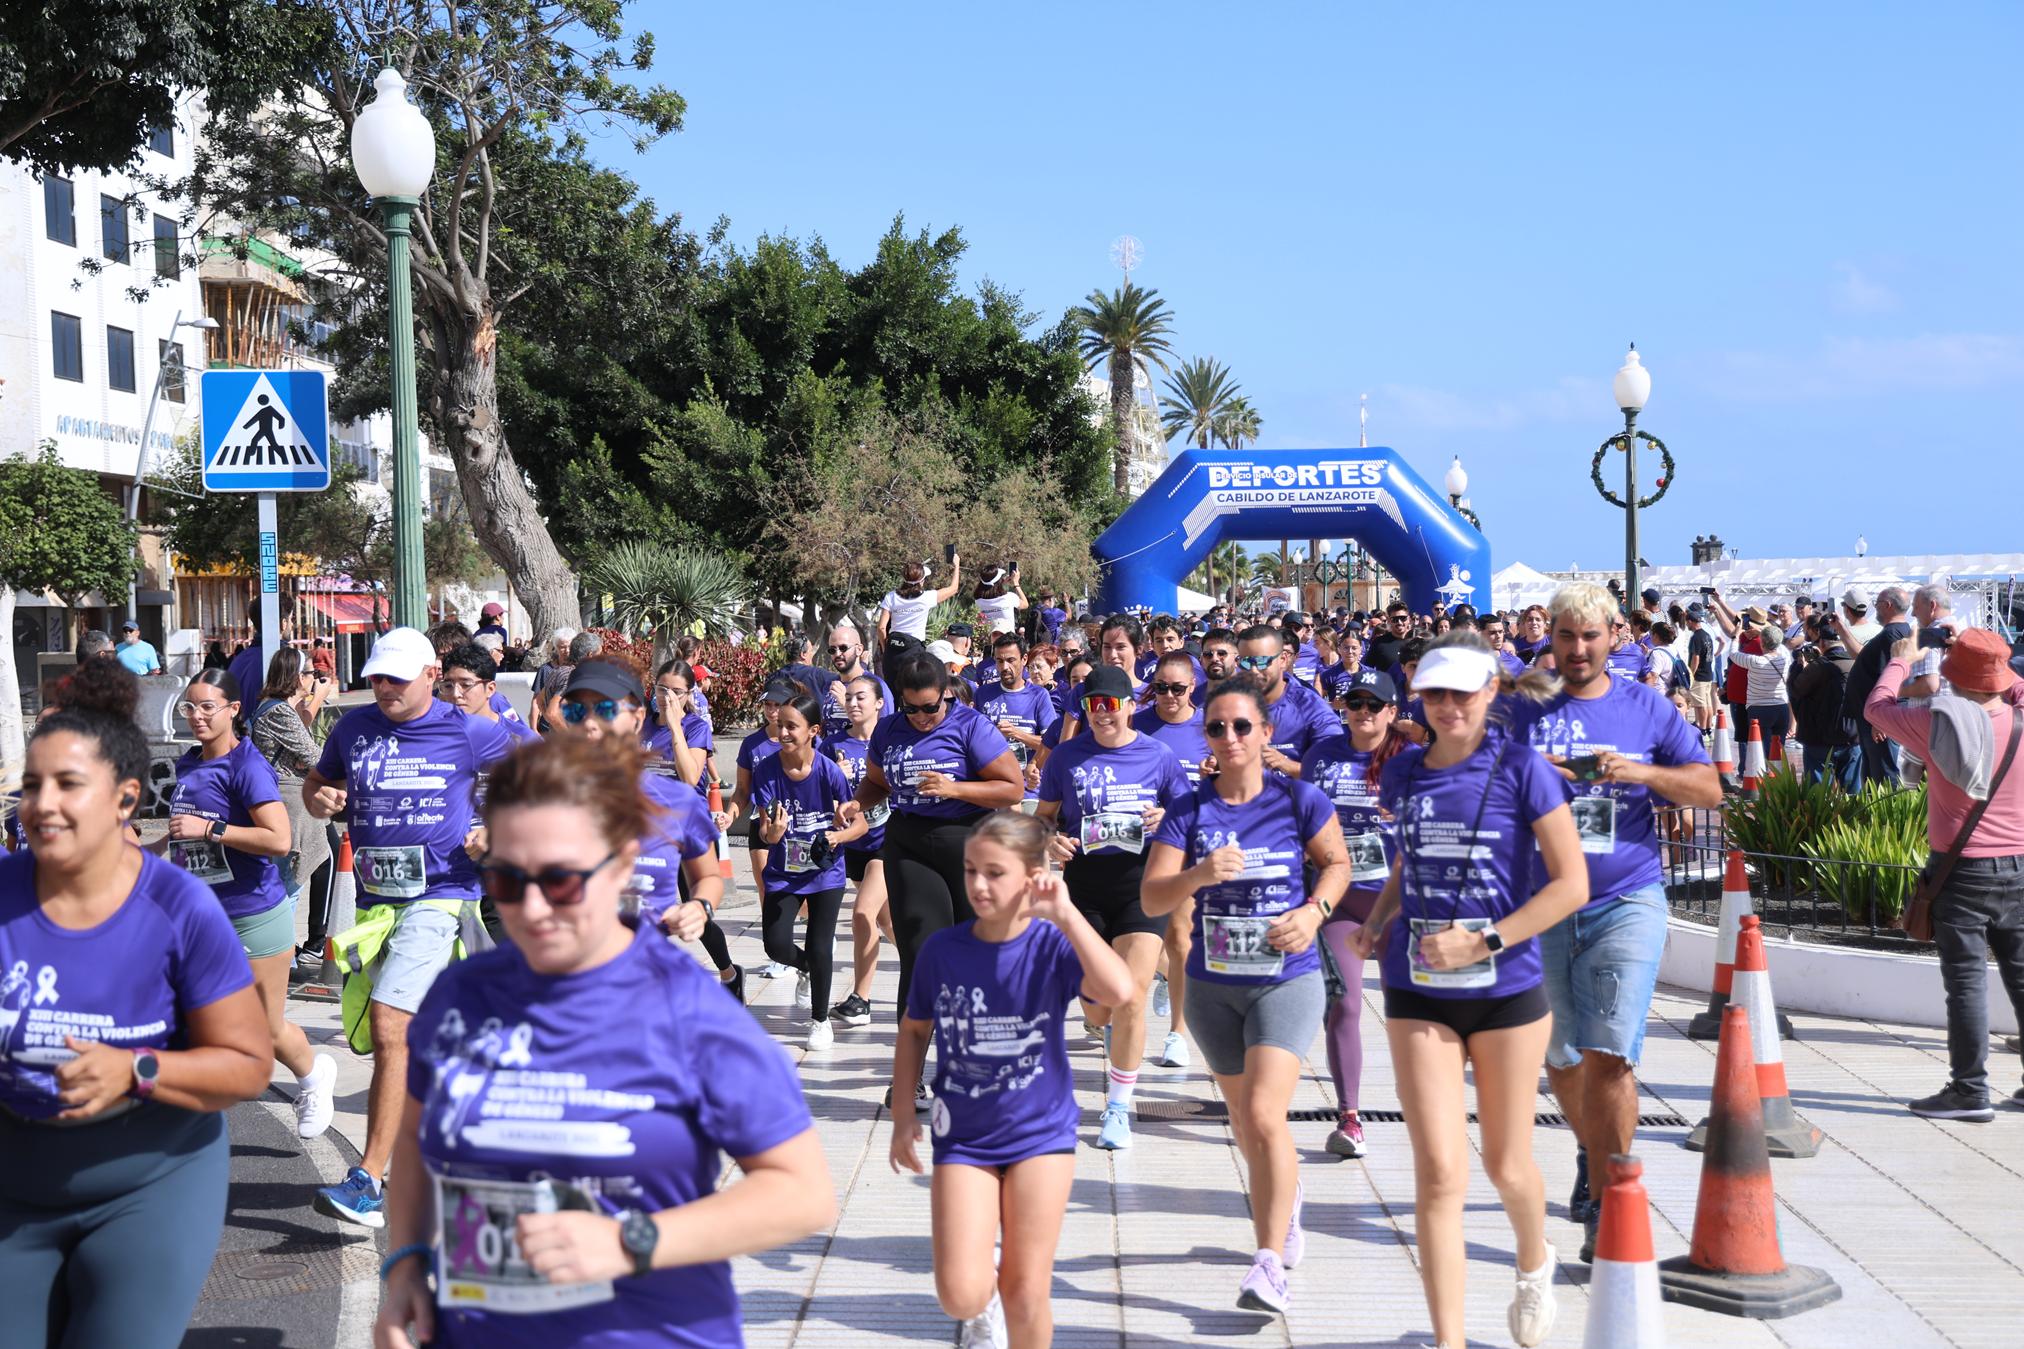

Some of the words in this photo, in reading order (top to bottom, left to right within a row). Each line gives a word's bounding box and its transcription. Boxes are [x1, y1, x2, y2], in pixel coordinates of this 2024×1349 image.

[1208, 464, 1382, 488] DEPORTES
[1217, 492, 1274, 503] CABILDO
[1278, 492, 1295, 502] DE
[1300, 490, 1375, 501] LANZAROTE
[185, 854, 210, 871] 112
[1349, 851, 1368, 865] 12
[372, 863, 405, 880] 016
[1226, 936, 1261, 955] 112
[53, 1010, 115, 1027] CARRERA
[26, 1021, 80, 1037] CONTRA
[81, 1026, 100, 1039] LA
[24, 1033, 43, 1045] DE
[476, 1221, 522, 1267] 01
